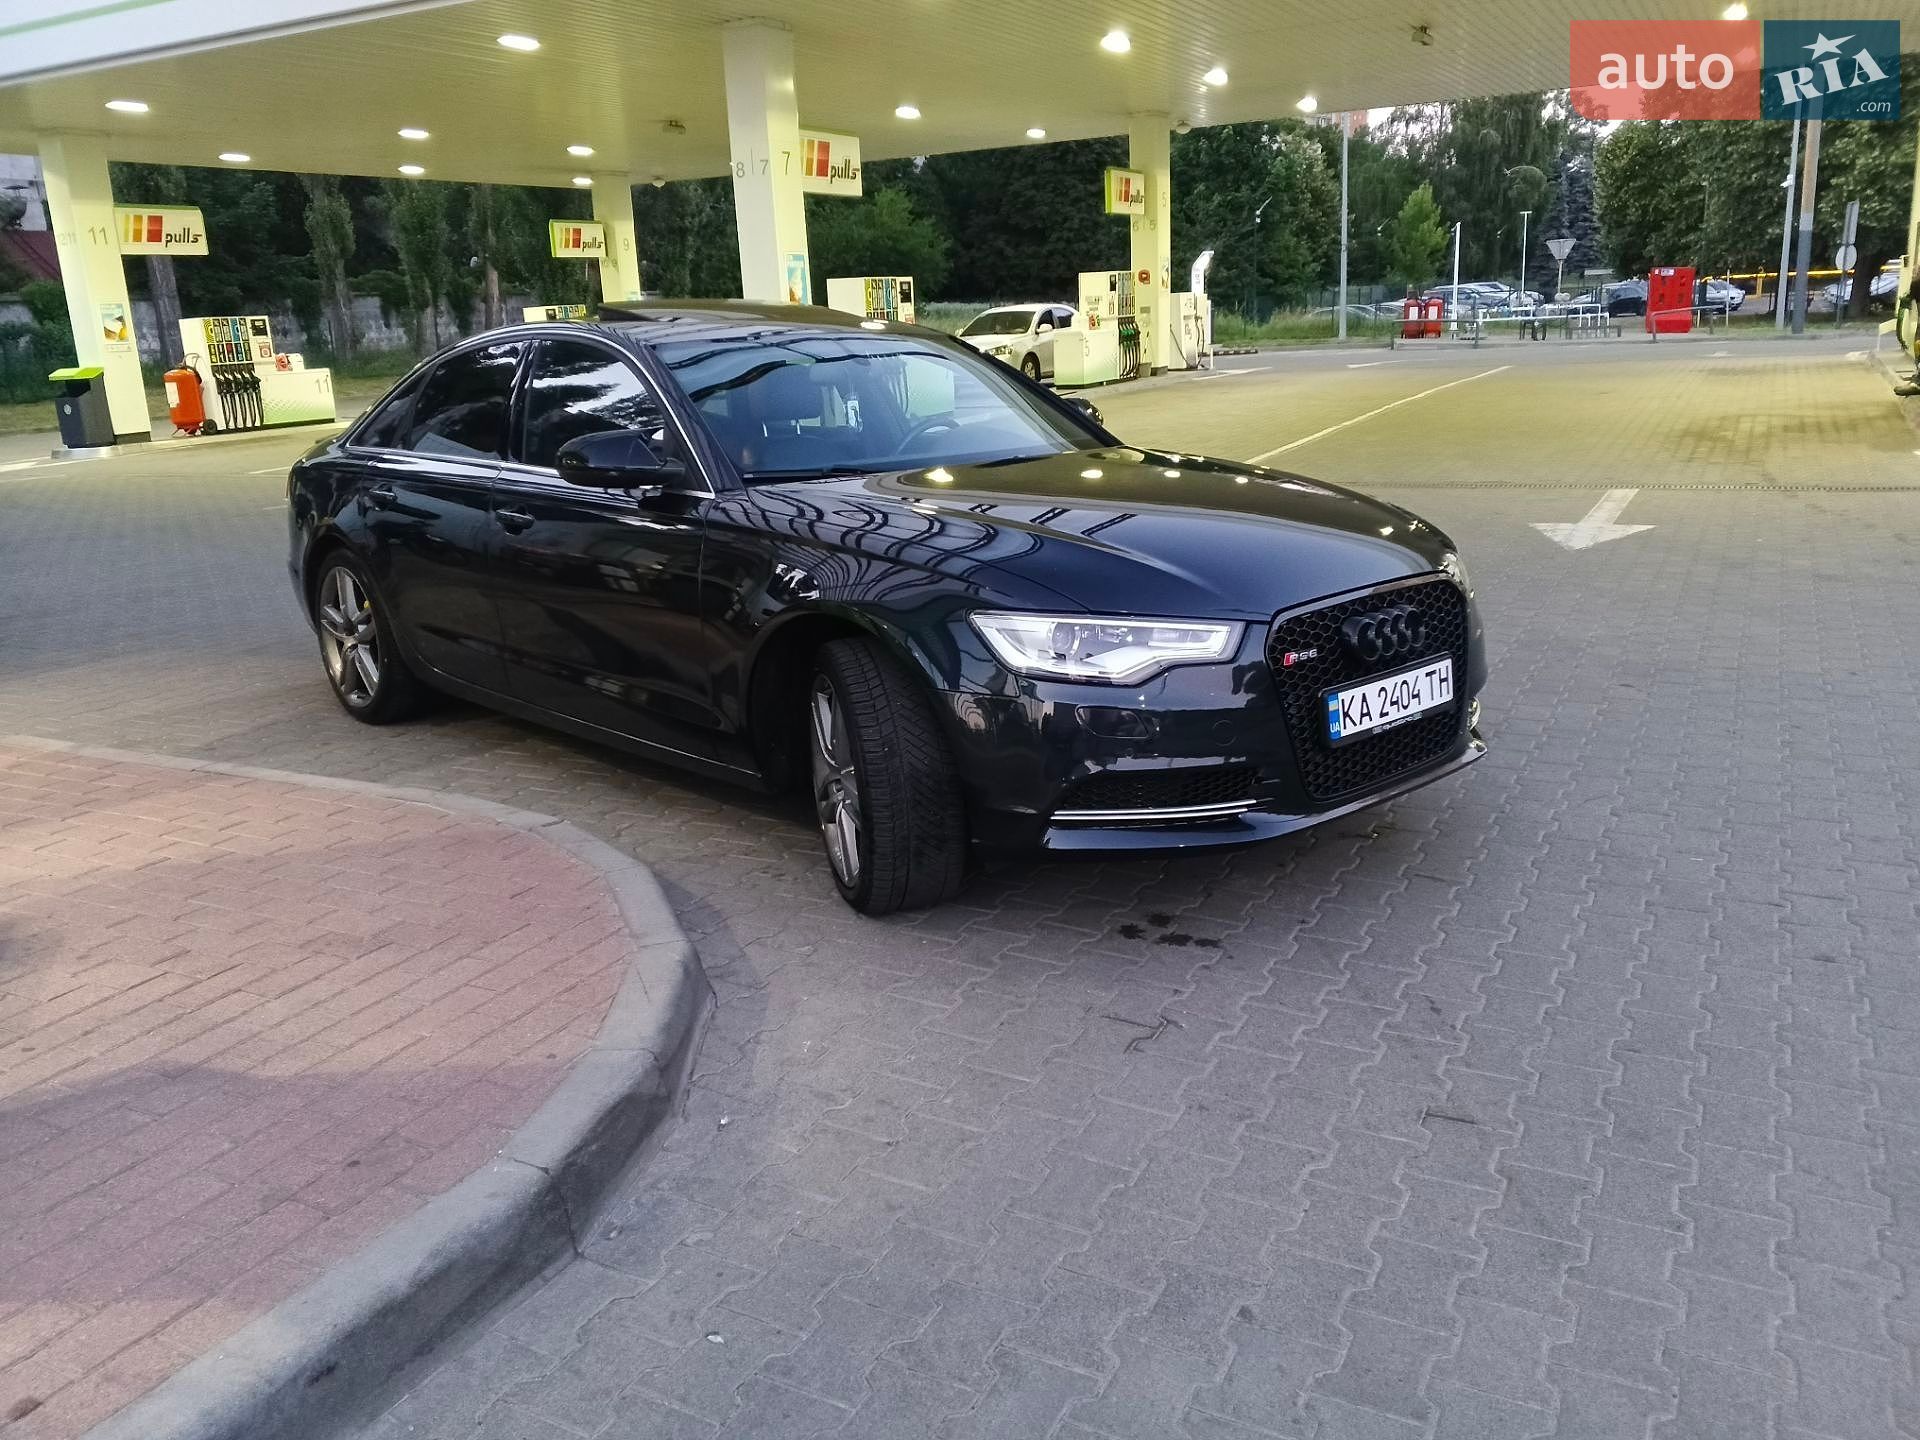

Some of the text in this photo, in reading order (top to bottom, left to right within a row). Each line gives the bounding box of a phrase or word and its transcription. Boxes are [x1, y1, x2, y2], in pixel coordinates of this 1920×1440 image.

[782, 151, 791, 176] 7
[830, 158, 860, 184] pulls
[165, 227, 202, 248] pulls
[582, 236, 603, 252] pulls
[1284, 648, 1318, 666] RS6
[1341, 665, 1450, 730] KA 2404 TH
[1329, 722, 1340, 733] UA
